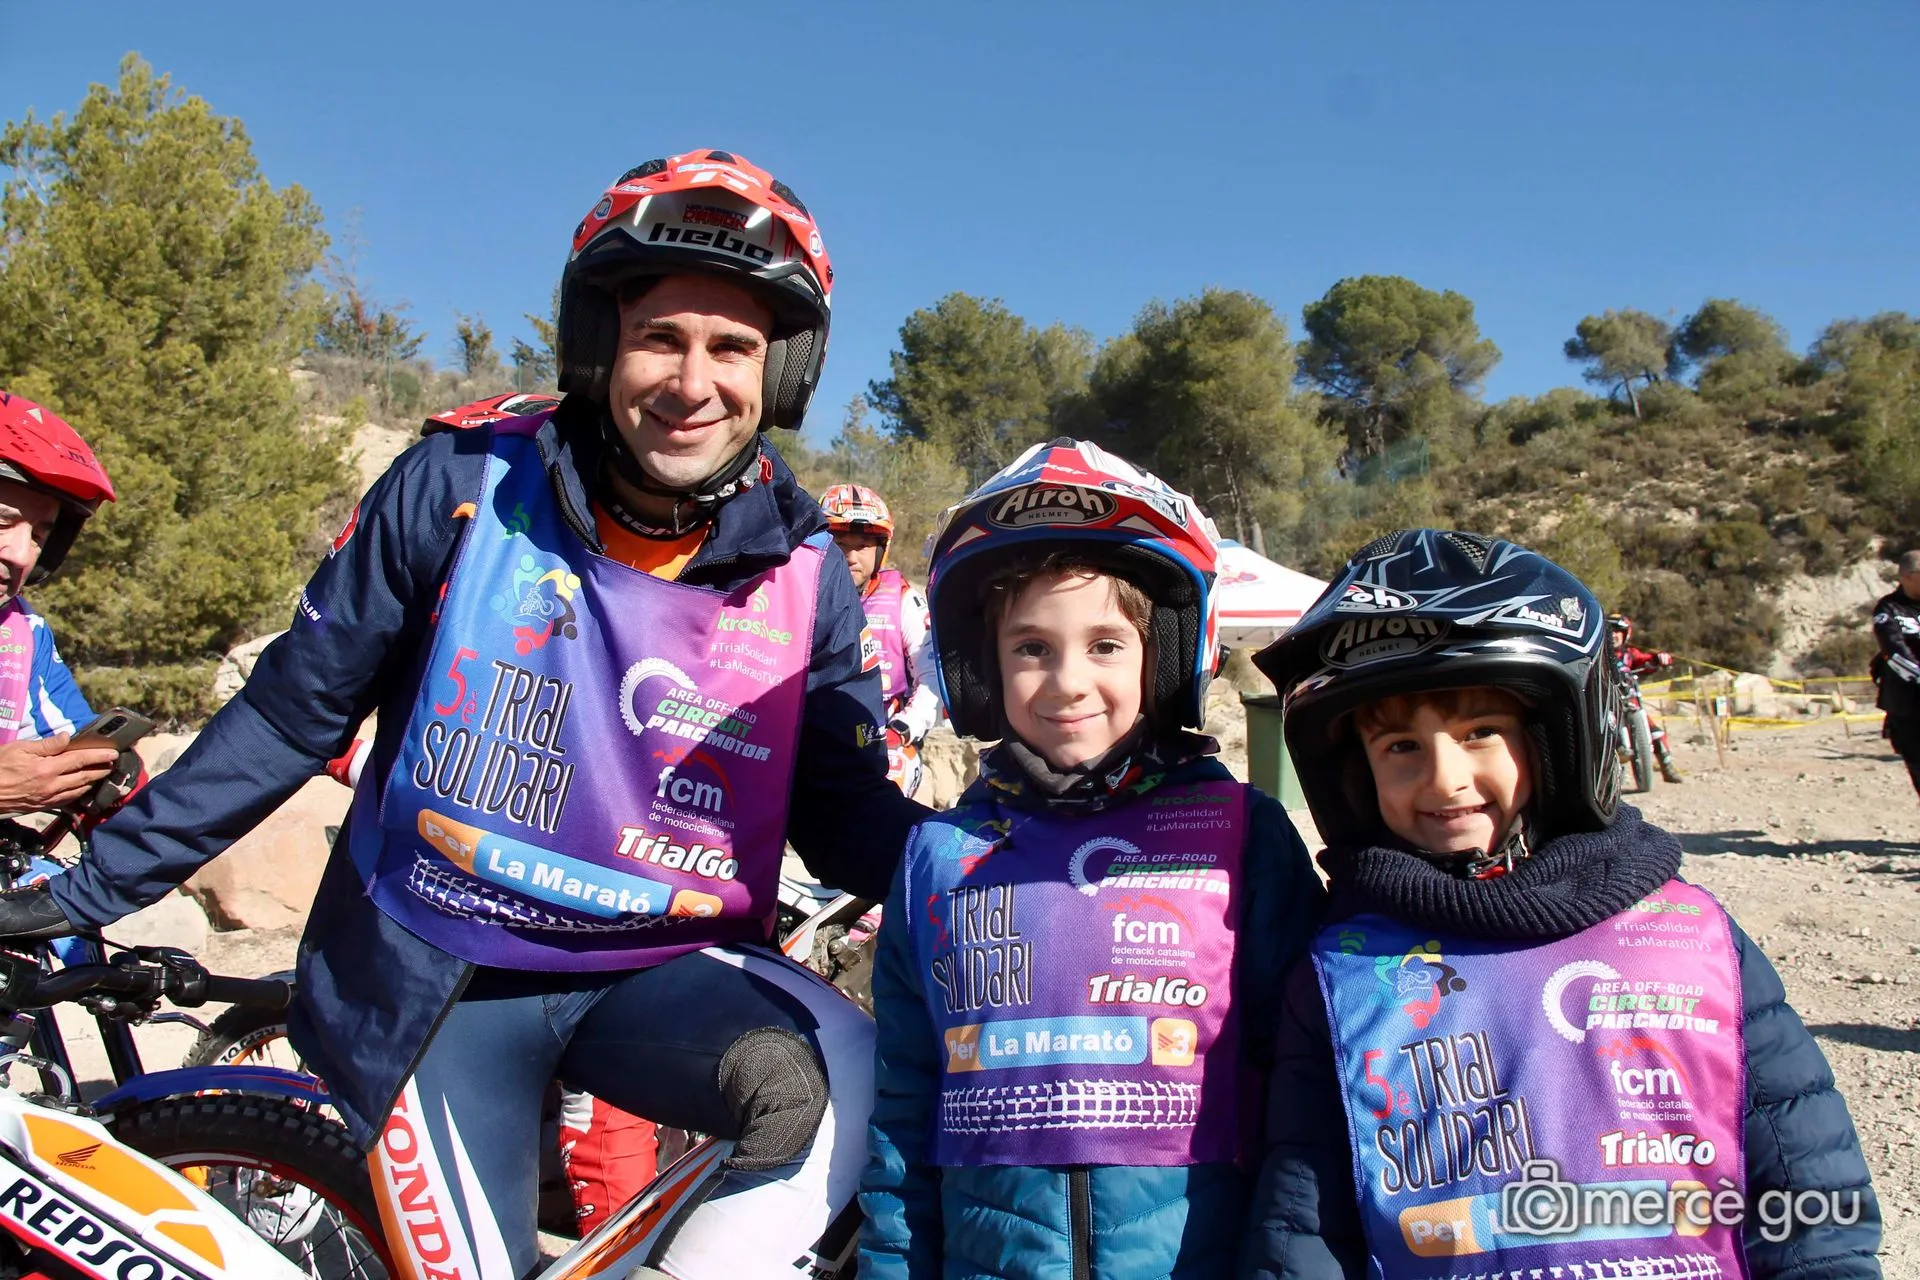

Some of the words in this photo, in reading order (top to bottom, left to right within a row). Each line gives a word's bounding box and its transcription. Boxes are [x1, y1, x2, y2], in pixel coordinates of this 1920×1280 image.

[648, 222, 774, 265] hebo
[996, 485, 1105, 521] Airoh
[1028, 511, 1069, 519] HELMET
[656, 699, 752, 738] CIRCUIT
[666, 687, 702, 706] AREA
[706, 698, 757, 724] OFF-ROAD
[645, 714, 771, 762] PARCMOTOR
[656, 765, 723, 812] fcm
[649, 812, 661, 822] de
[664, 817, 725, 838] motociclisme
[1147, 808, 1223, 820] #TrialSolidari
[425, 820, 471, 857] Per
[488, 848, 525, 880] La
[531, 862, 651, 915] Marató
[617, 827, 740, 881] TrialGo
[1113, 854, 1147, 863] AREA
[1152, 854, 1217, 863] OFF-ROAD
[1106, 863, 1214, 876] CIRCUIT
[1112, 913, 1180, 945] fcm
[1614, 921, 1699, 935] #TrialSolidari
[1111, 956, 1123, 965] de
[1126, 957, 1187, 967] motociclisme
[1088, 973, 1209, 1008] TrialGo
[1592, 982, 1631, 994] AREA
[1635, 981, 1704, 996] OFF-ROAD
[1589, 994, 1701, 1015] CIRCUIT
[1585, 1013, 1720, 1035] PARCMOTOR
[989, 1034, 1019, 1057] La
[1025, 1028, 1134, 1055] Marató
[1610, 1059, 1682, 1096] fcm
[1599, 1131, 1717, 1168] TrialGo
[54, 1160, 97, 1170] HONDA
[0, 1177, 190, 1280] REPSO
[1409, 1219, 1465, 1245] Per
